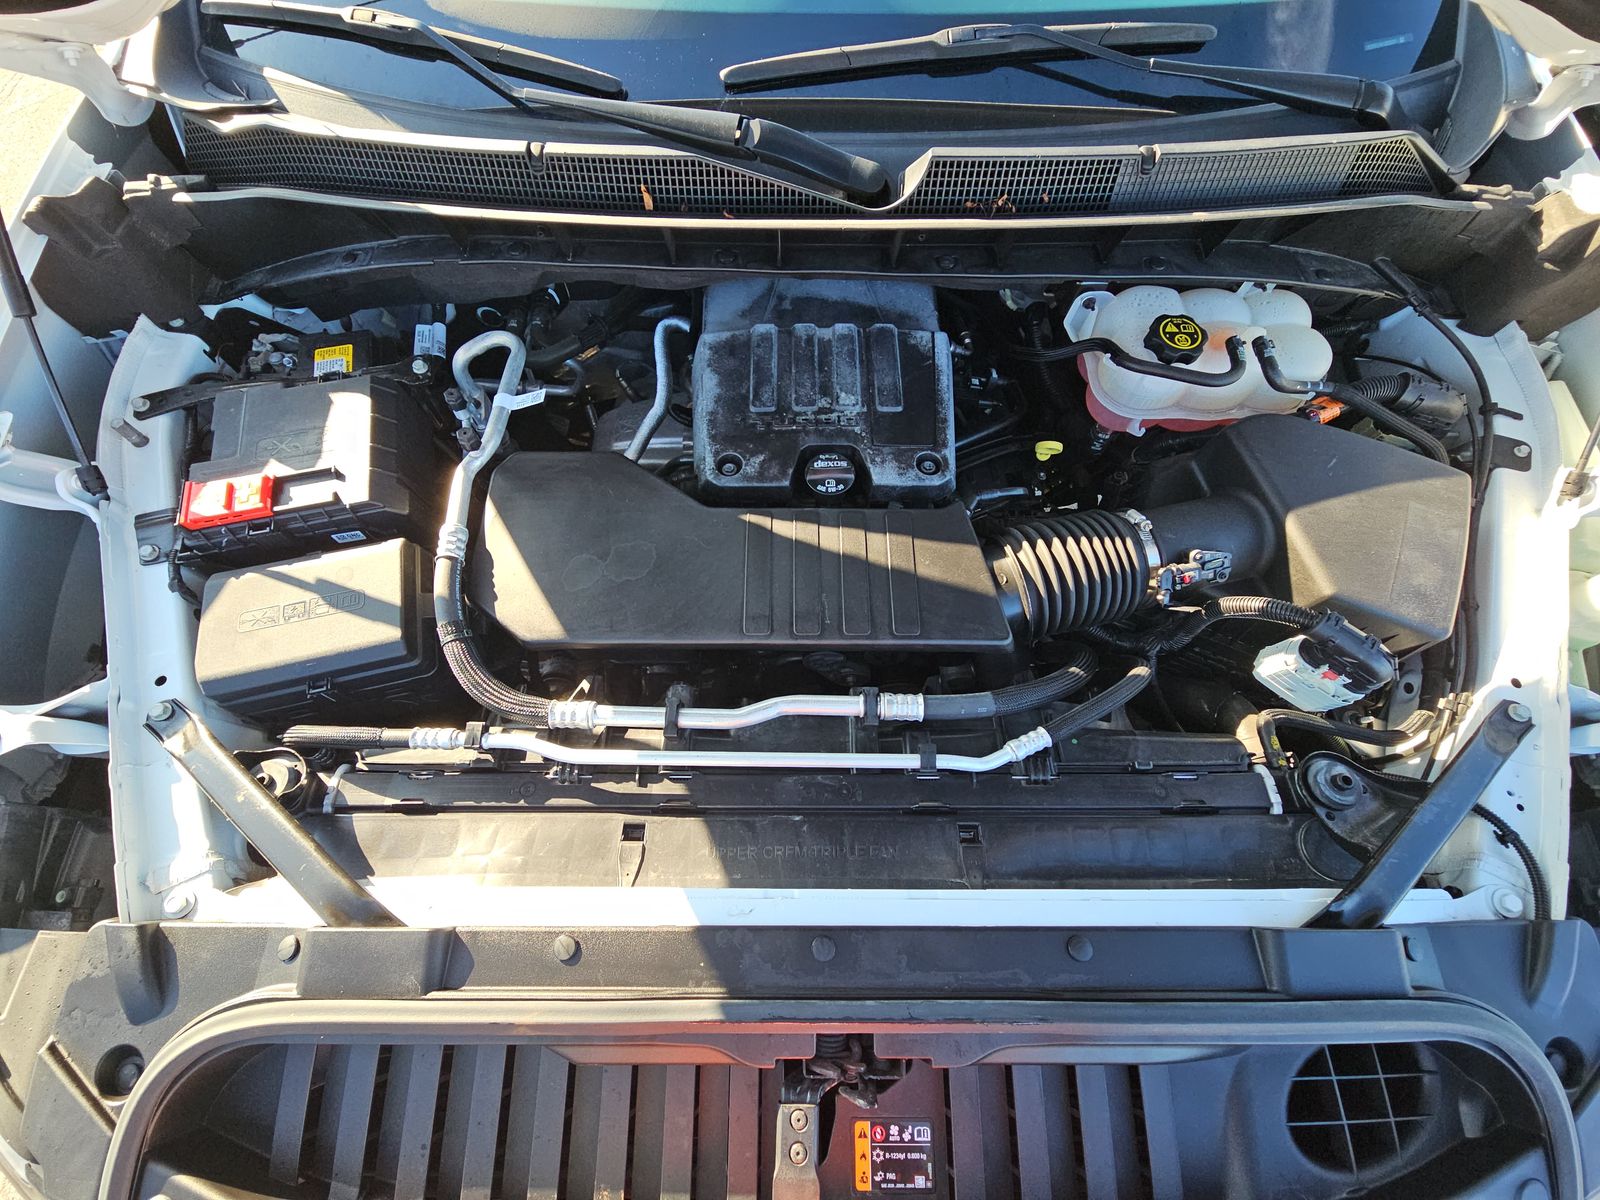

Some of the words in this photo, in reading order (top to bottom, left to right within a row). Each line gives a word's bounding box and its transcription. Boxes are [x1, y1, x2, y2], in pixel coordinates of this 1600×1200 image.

[813, 460, 848, 468] dexos
[705, 846, 758, 859] UPPER
[811, 845, 866, 860] TRIPLE
[869, 845, 899, 858] FAN
[886, 1172, 896, 1180] PAG
